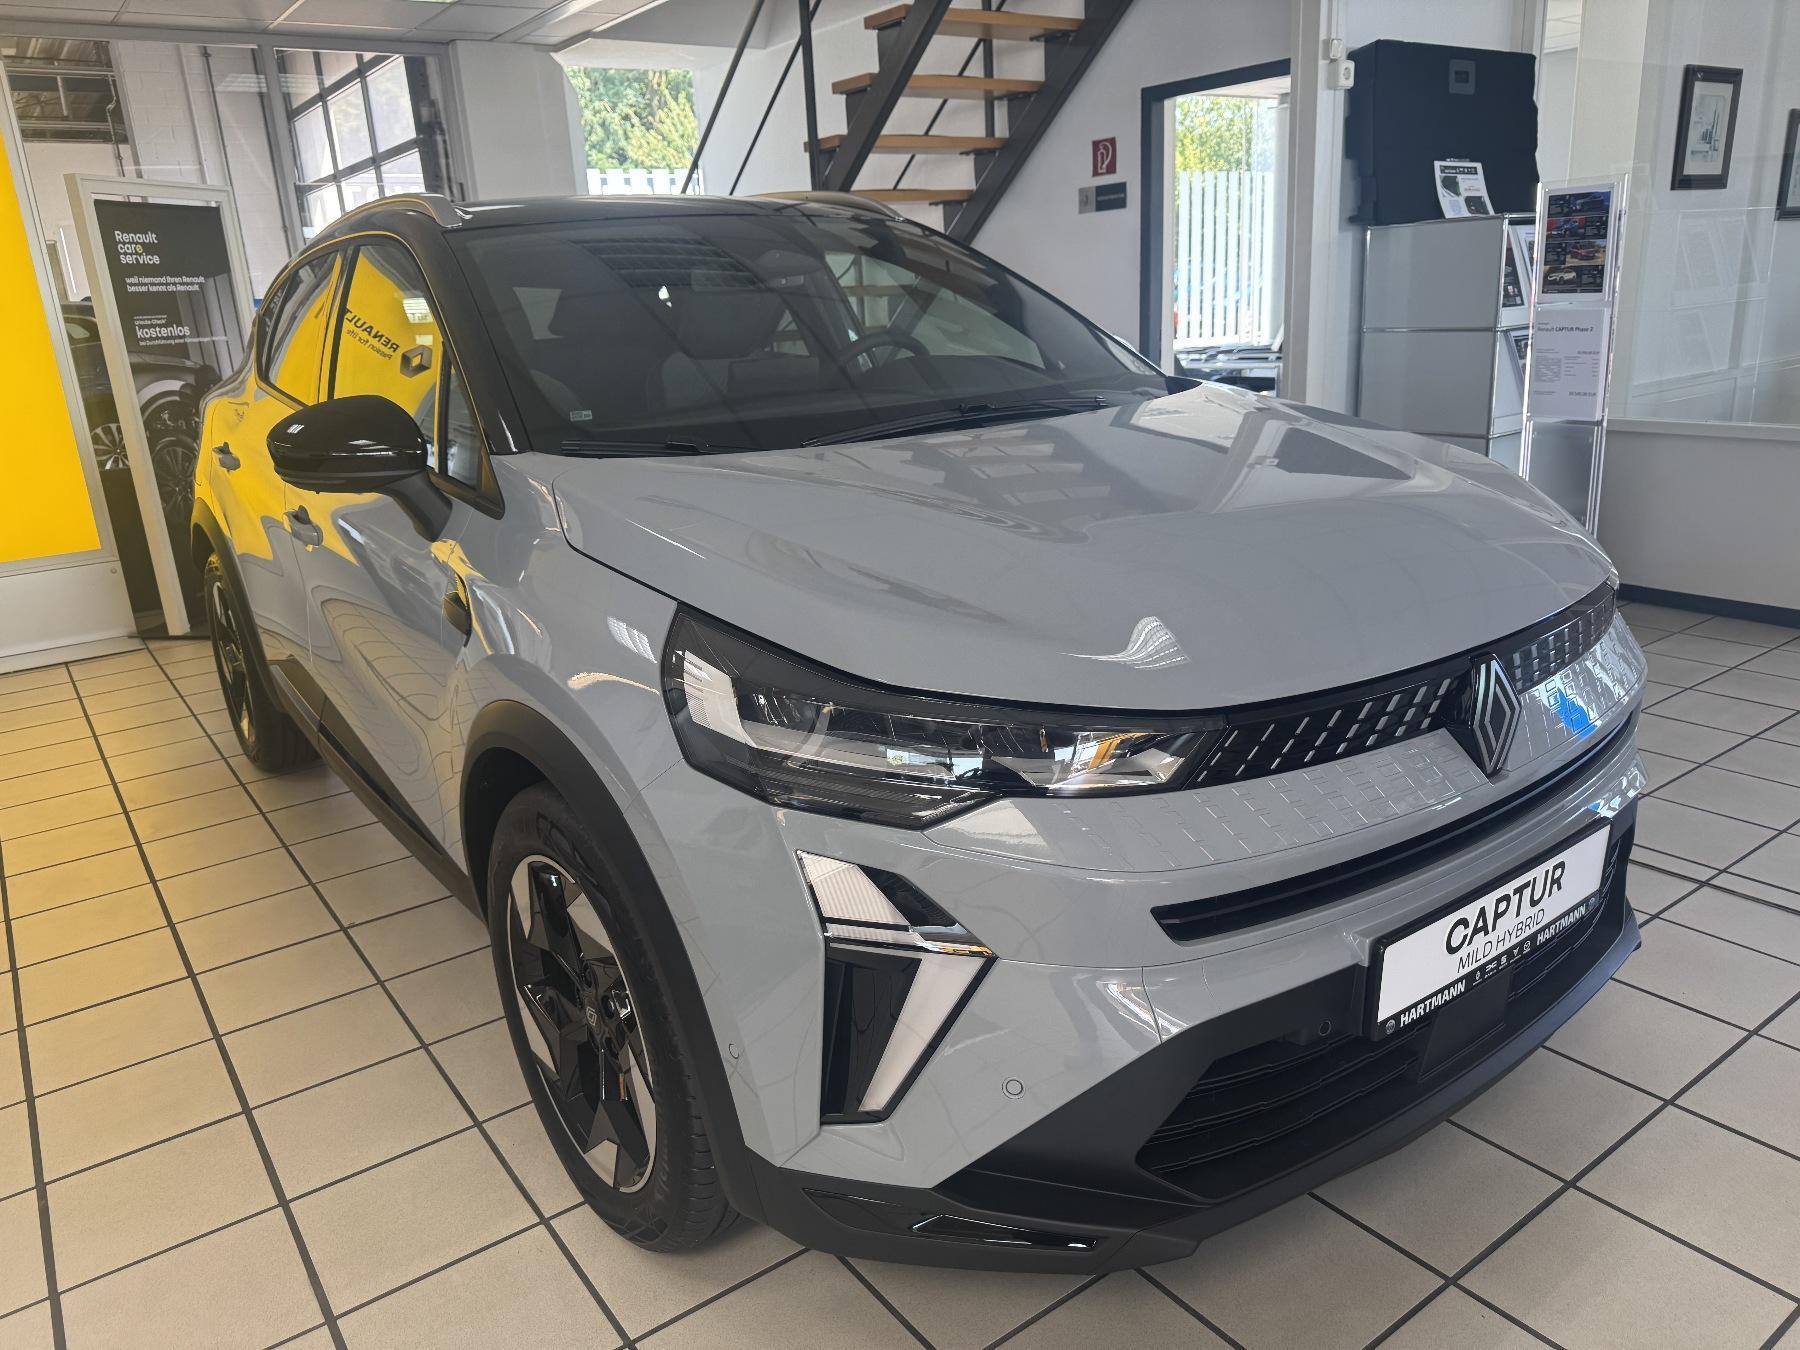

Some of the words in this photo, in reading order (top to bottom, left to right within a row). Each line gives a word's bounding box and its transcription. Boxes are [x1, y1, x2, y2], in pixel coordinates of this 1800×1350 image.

[114, 231, 158, 243] Renault
[117, 244, 143, 254] care
[120, 253, 160, 264] service
[136, 324, 190, 338] kostenlos
[1445, 860, 1566, 955] CAPTUR
[1457, 941, 1493, 973] MILD
[1496, 908, 1545, 952] HYBRID
[1400, 979, 1466, 1028] HARTMANN
[1536, 905, 1586, 946] HARTMANN
